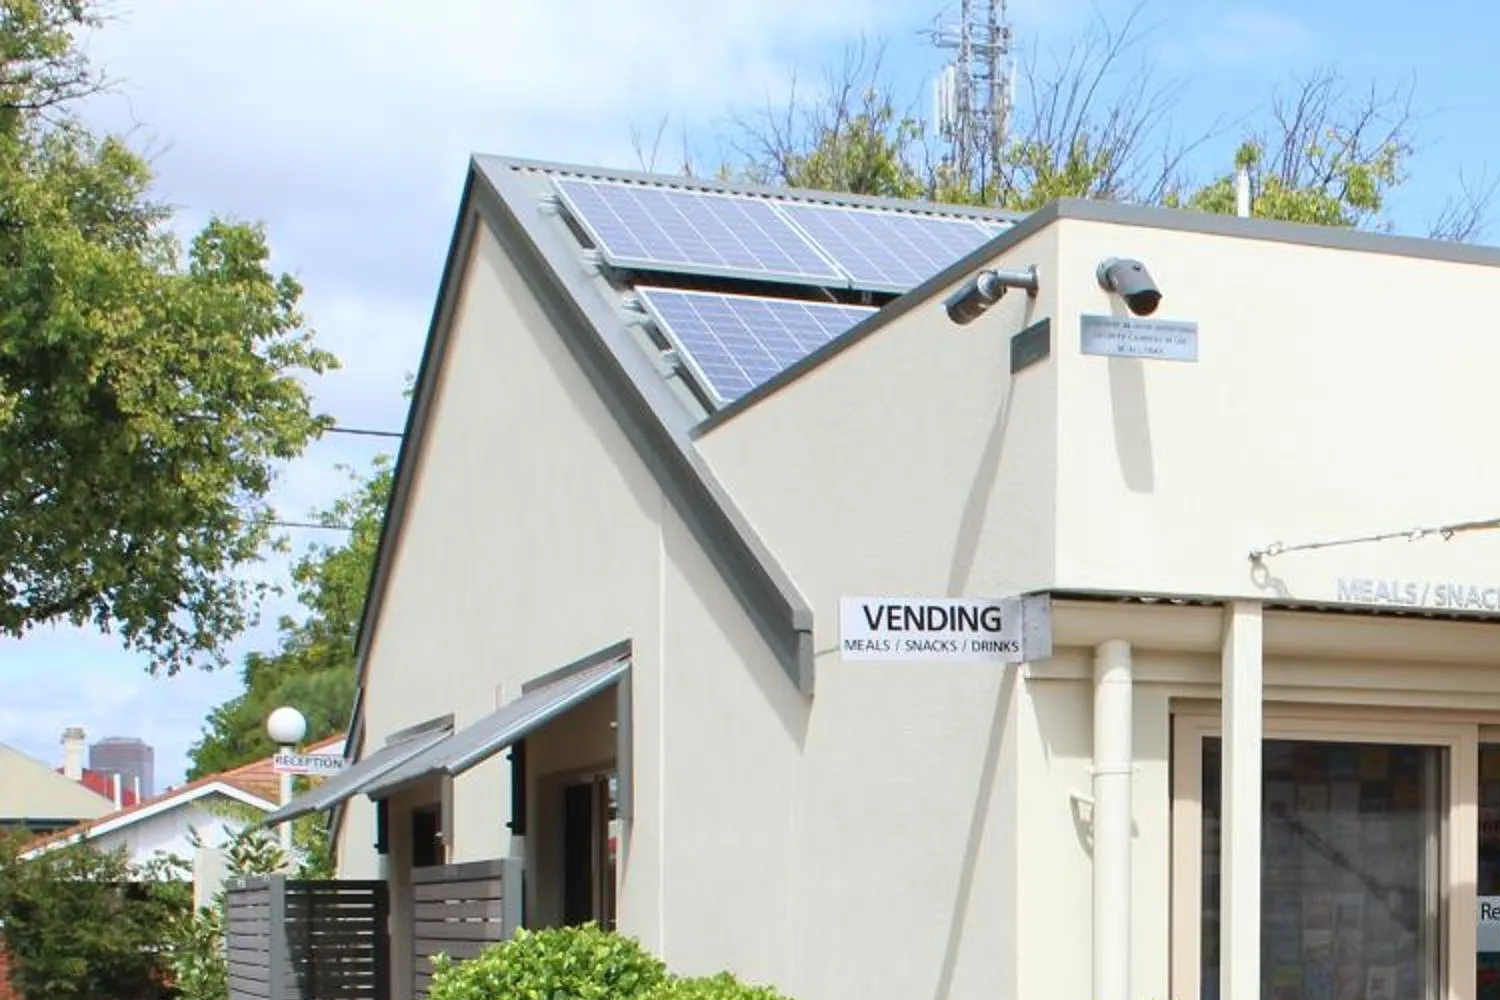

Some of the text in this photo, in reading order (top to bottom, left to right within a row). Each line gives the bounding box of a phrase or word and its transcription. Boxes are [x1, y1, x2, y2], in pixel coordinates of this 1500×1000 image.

[1337, 577, 1417, 604] MEALS
[863, 604, 1002, 633] VENDING
[844, 638, 890, 650] MEALS
[905, 639, 957, 652] SNACKS
[971, 639, 1020, 652] DRINKS
[275, 755, 343, 768] RECEPTION
